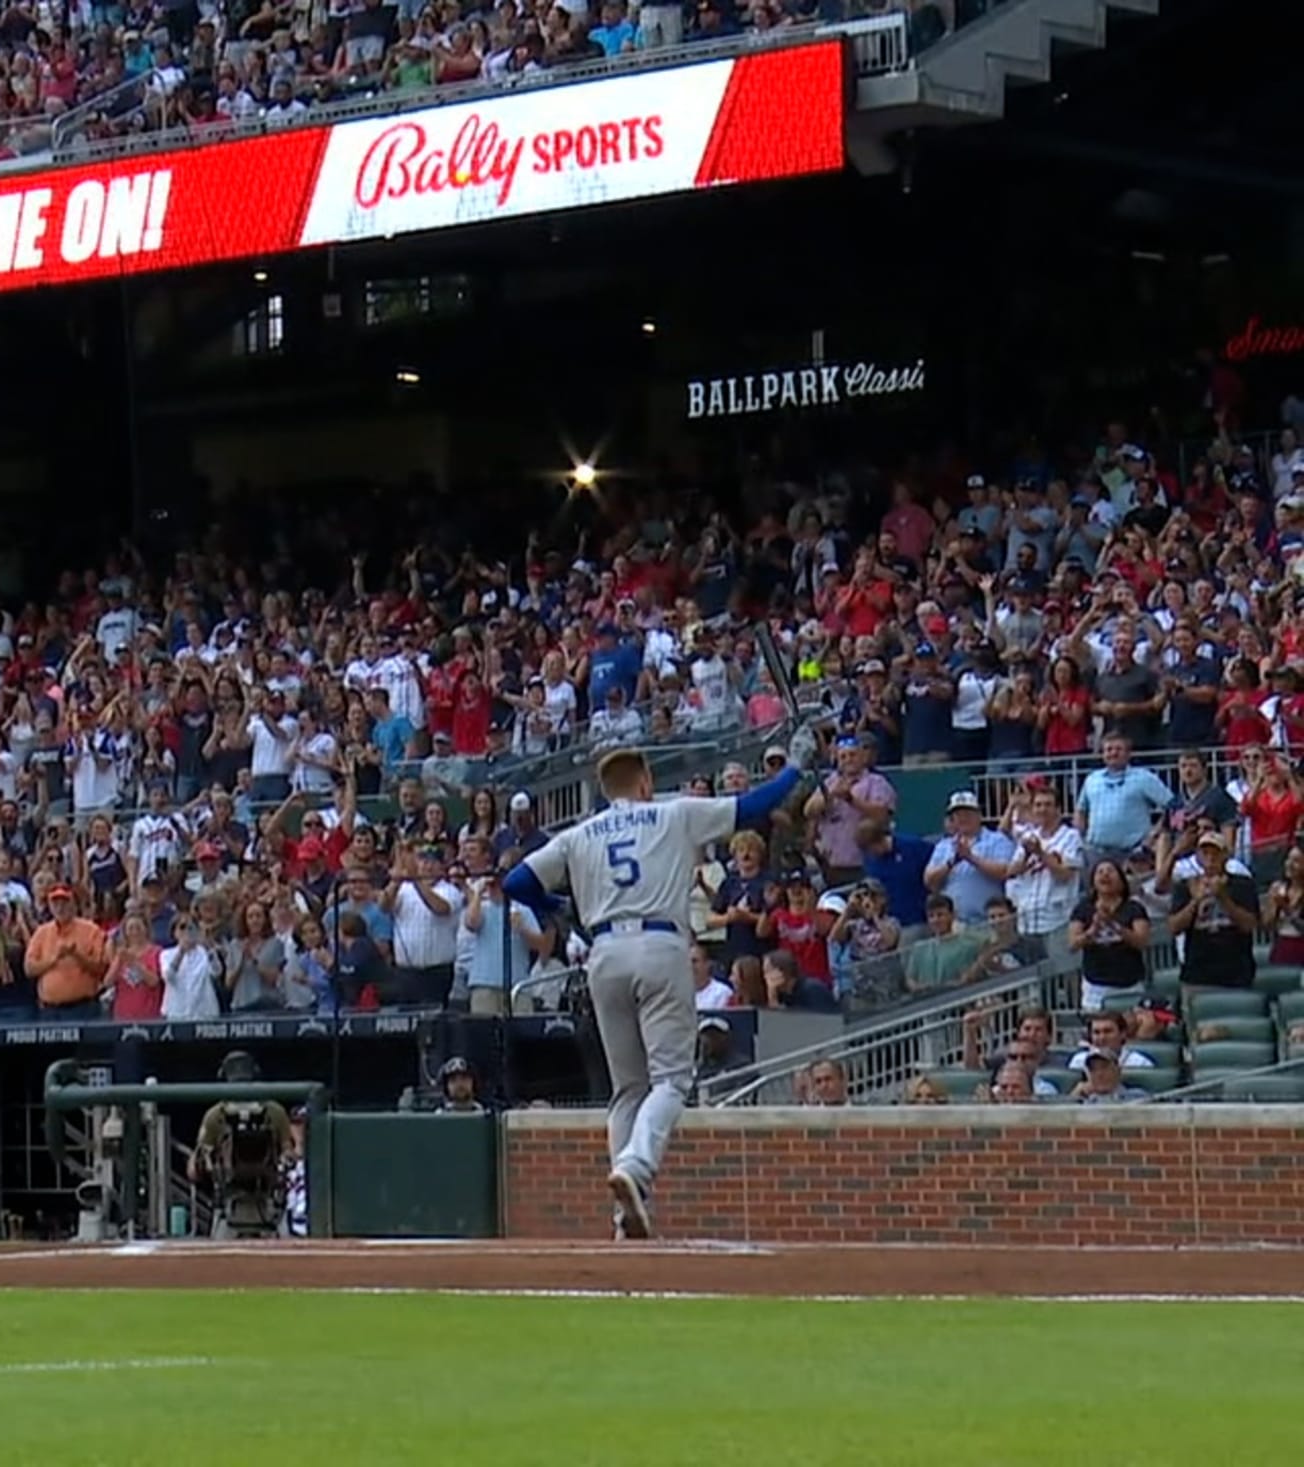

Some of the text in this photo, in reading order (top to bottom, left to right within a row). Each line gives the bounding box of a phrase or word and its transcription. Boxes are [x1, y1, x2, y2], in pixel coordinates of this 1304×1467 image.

[355, 113, 664, 209] Bally SPORTS
[60, 169, 173, 263] ON!
[688, 359, 925, 419] BALLPARK Classi
[585, 806, 658, 839] FREEMAN
[607, 838, 641, 889] 5
